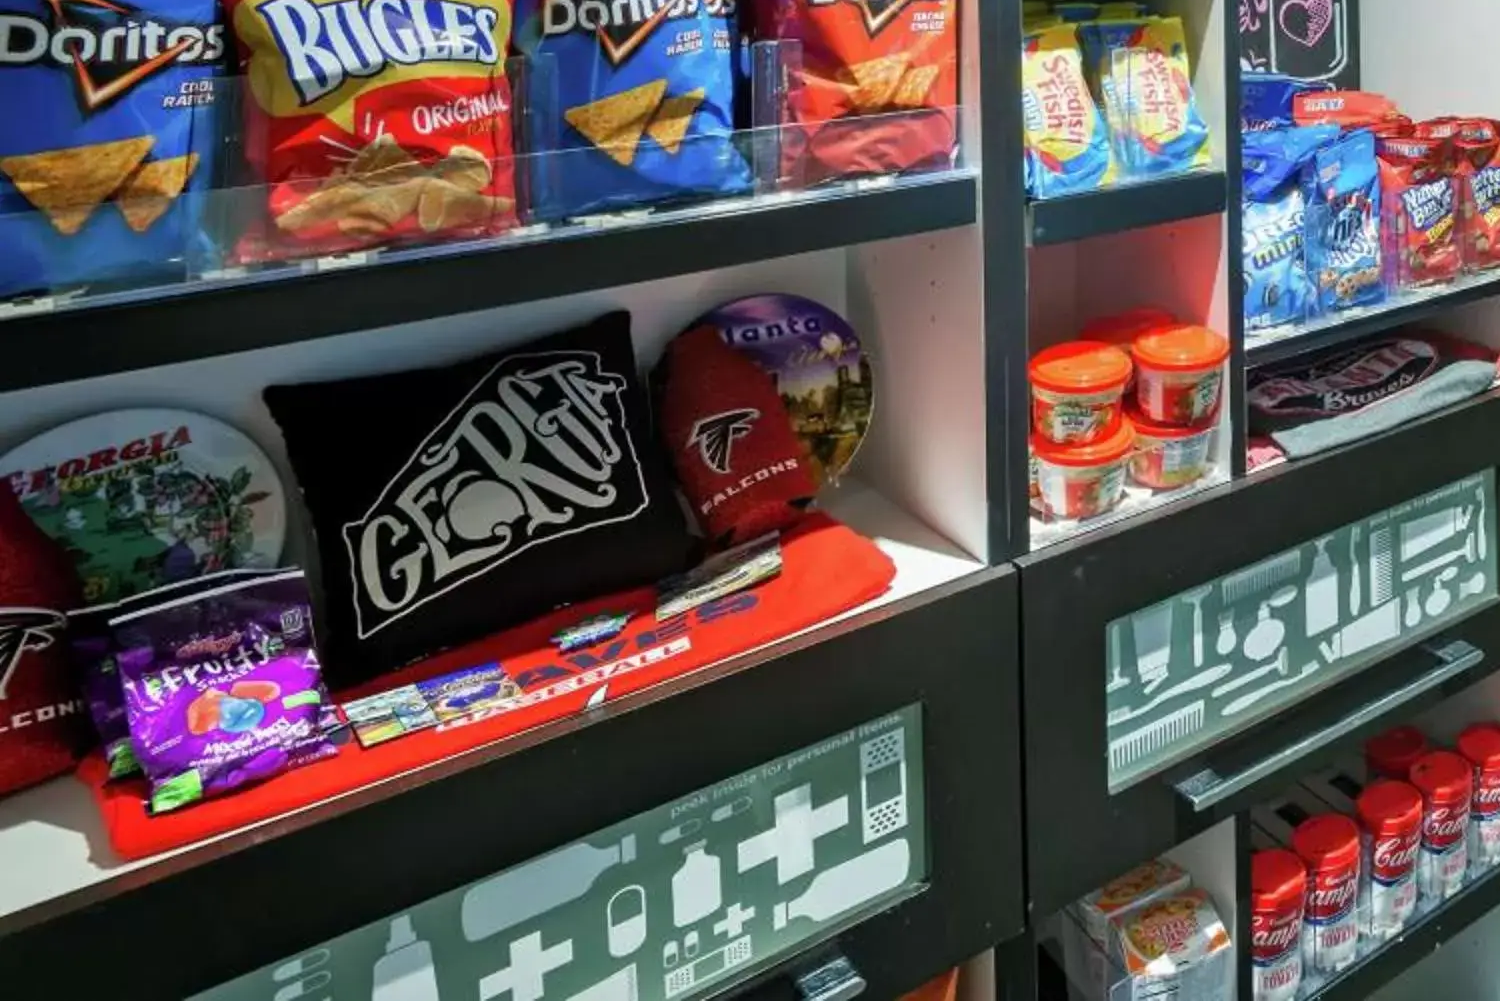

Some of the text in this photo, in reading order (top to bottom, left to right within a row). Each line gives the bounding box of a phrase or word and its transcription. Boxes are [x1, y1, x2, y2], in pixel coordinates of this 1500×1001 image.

[0, 13, 225, 63] Doritos
[1037, 79, 1066, 130] Fish
[1042, 54, 1085, 145] Swedish
[360, 361, 618, 612] GEORGIA
[701, 457, 799, 515] FALCONS
